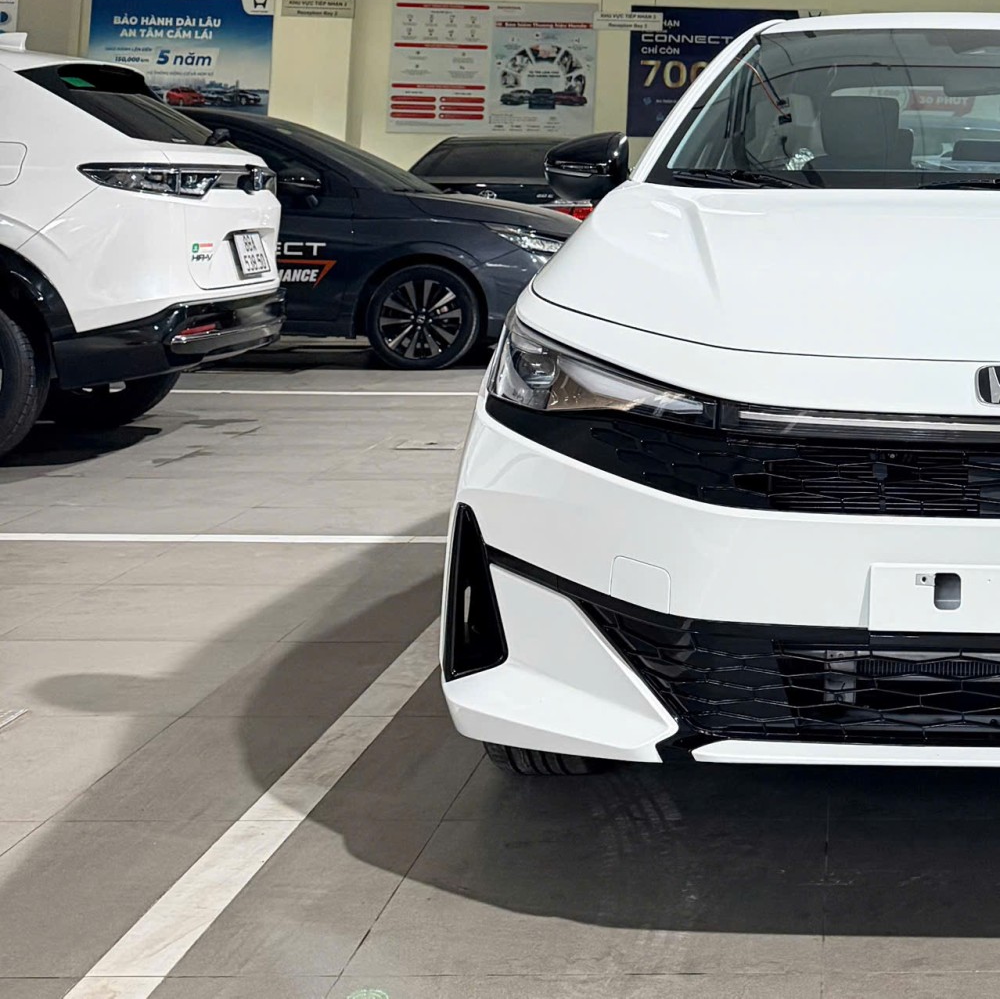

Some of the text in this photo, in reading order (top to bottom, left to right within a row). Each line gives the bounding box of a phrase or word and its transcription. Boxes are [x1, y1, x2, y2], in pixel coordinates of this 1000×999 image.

[113, 13, 221, 28] BẢO HÀNH DÀI LÂU
[120, 26, 213, 40] AN TÂM CẦM LÁI
[641, 33, 734, 44] CONNECT
[641, 45, 680, 55] CHỈ CÒN
[156, 49, 212, 66] 5 năm
[277, 242, 326, 256] CT
